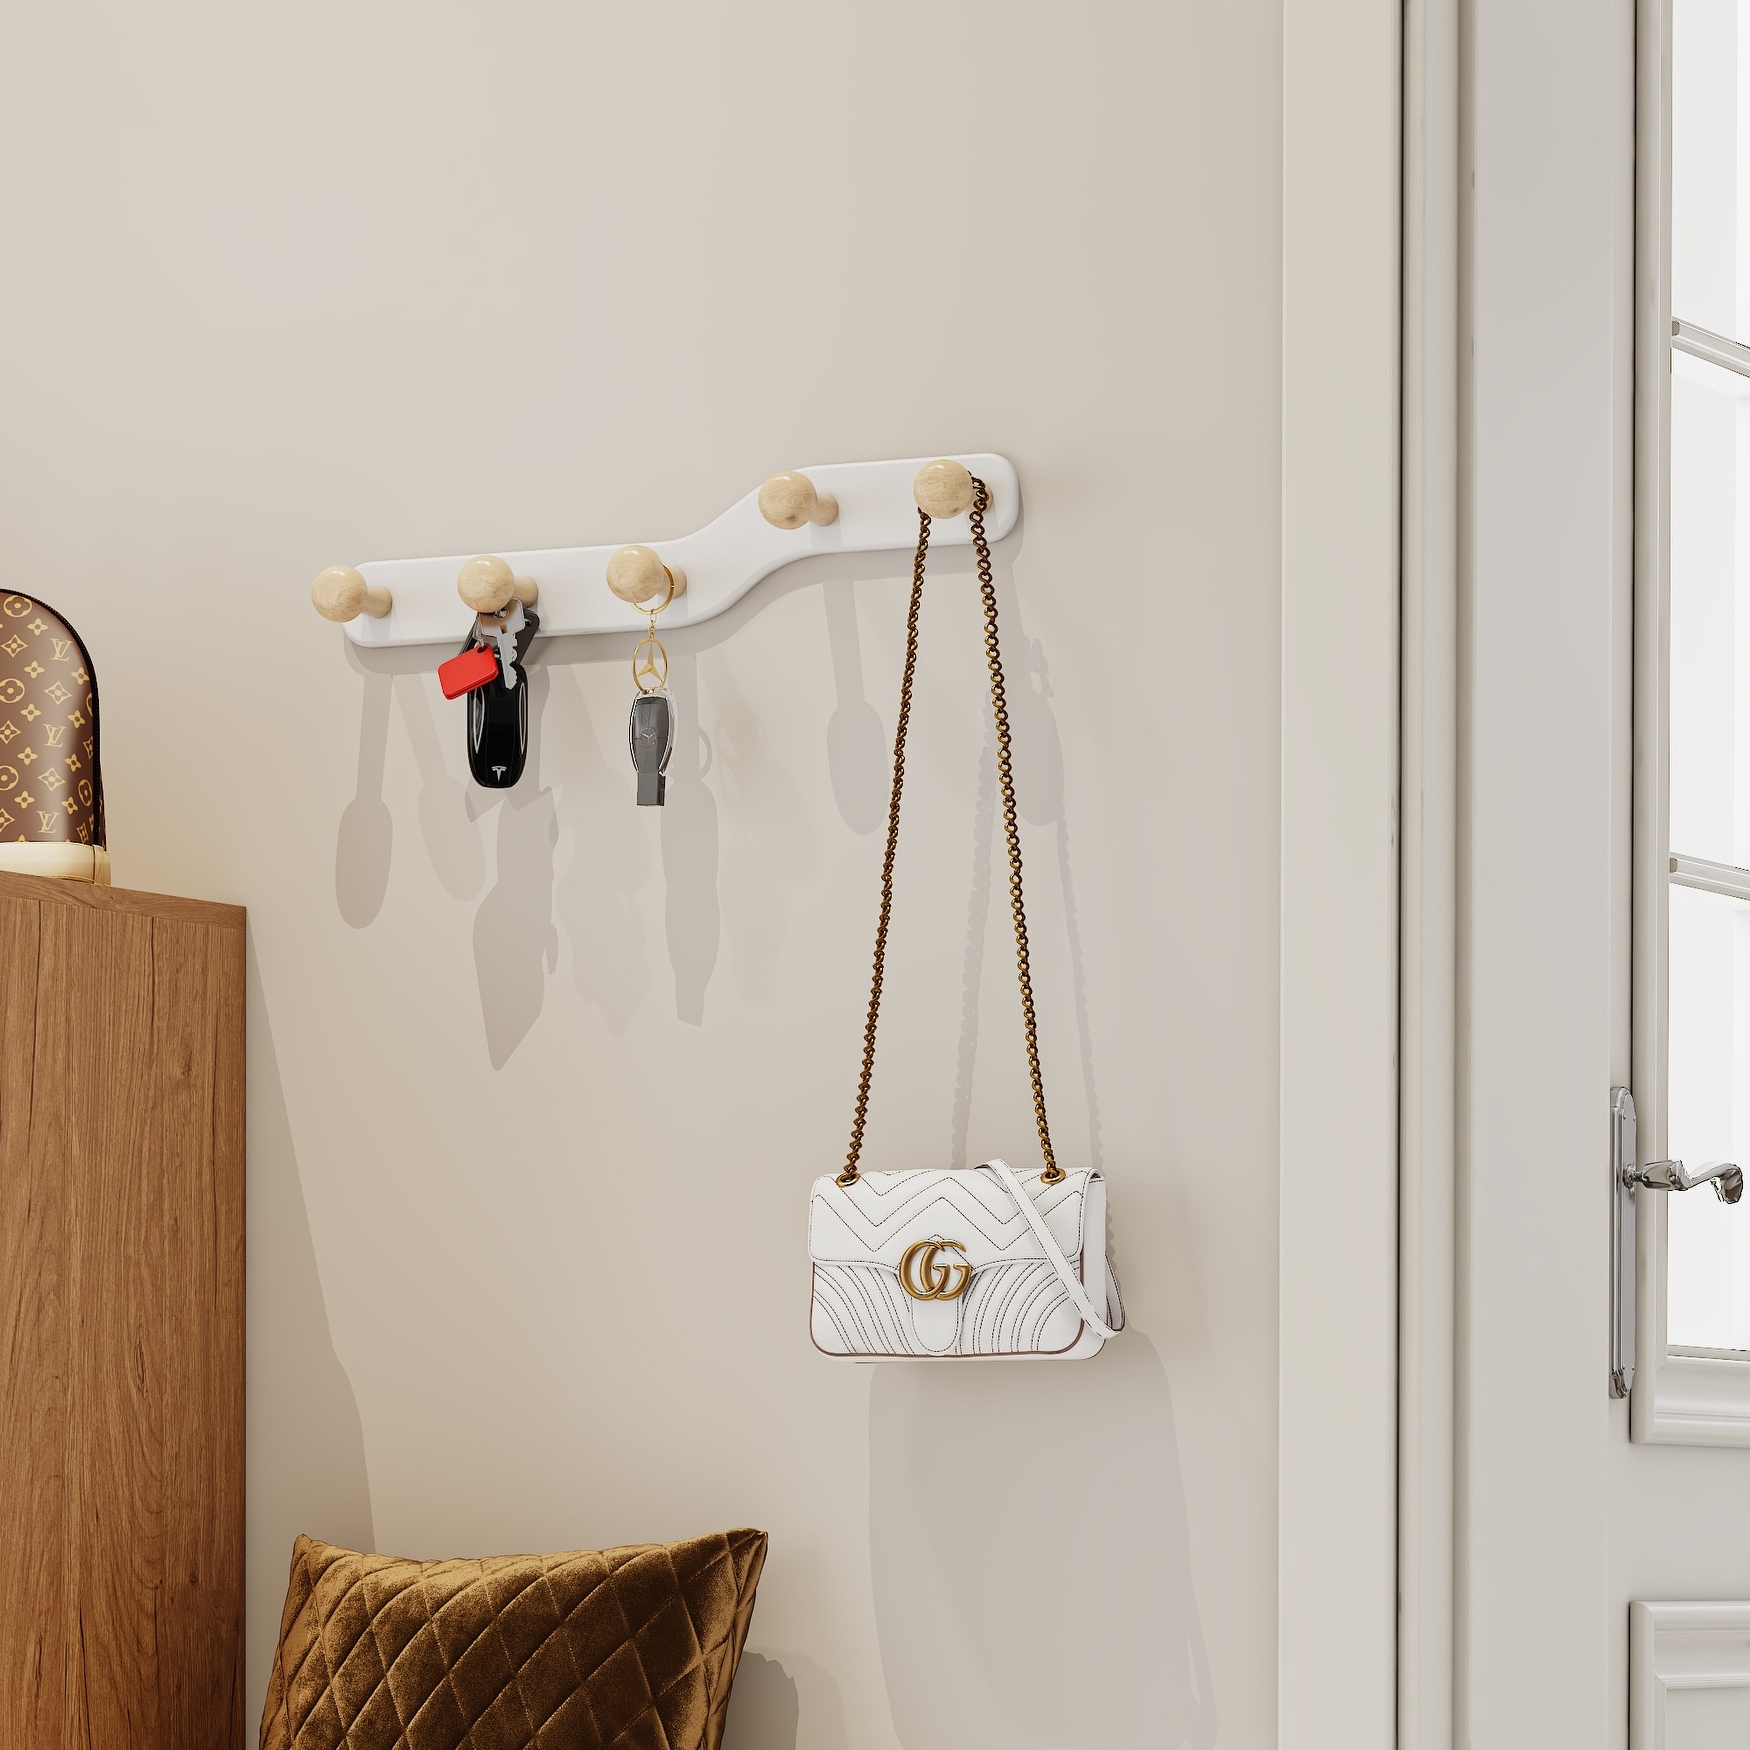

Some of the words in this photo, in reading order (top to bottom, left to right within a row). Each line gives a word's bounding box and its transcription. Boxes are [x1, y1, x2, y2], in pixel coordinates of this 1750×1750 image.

[51, 638, 73, 662] LV
[43, 724, 66, 747] LV
[37, 810, 59, 834] LV
